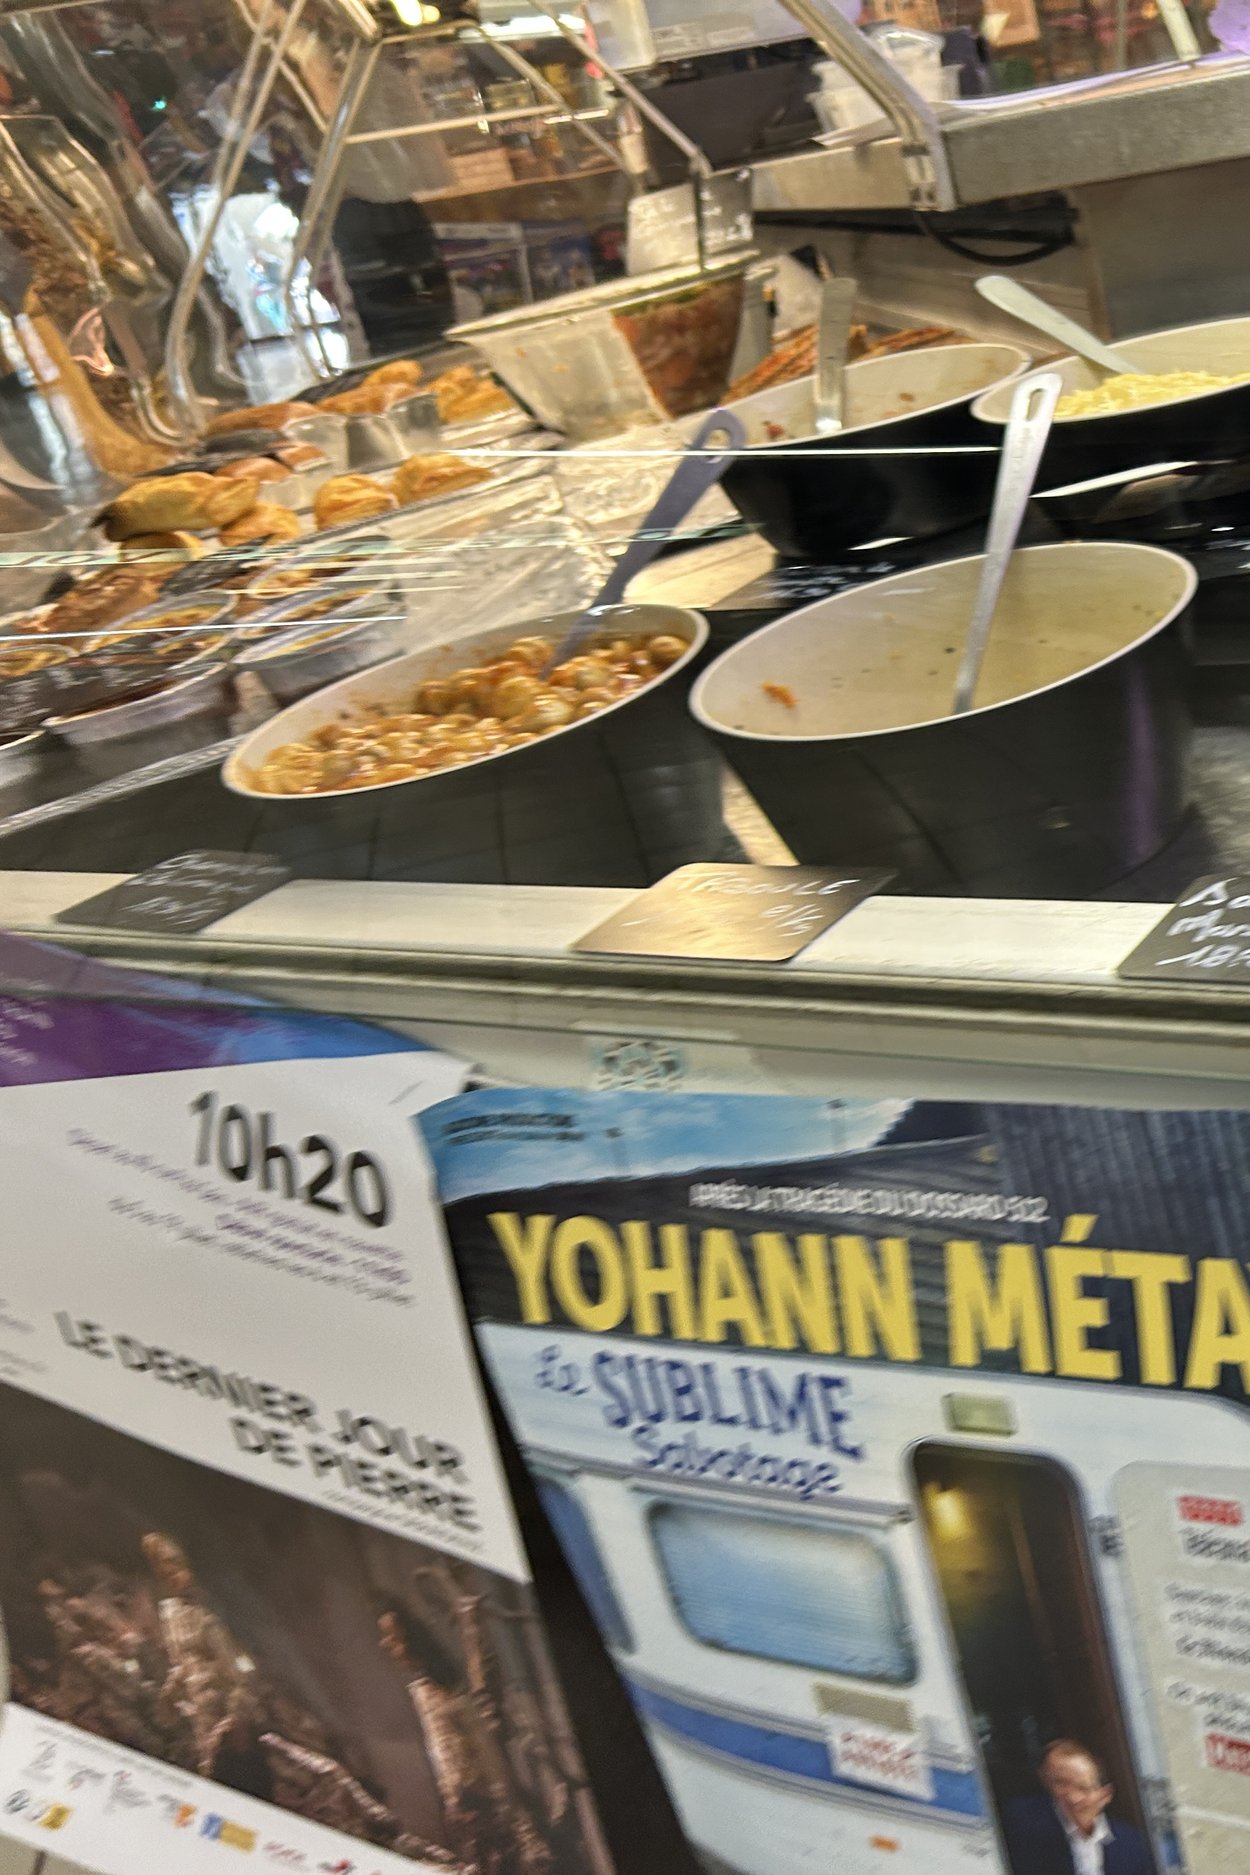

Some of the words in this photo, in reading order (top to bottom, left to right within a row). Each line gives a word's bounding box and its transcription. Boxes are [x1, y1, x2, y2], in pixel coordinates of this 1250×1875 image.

[188, 1090, 391, 1229] 10h20
[487, 1209, 922, 1364] YOHANN
[53, 1311, 113, 1359] LE
[112, 1334, 323, 1432] DERNIER
[333, 1408, 469, 1484] JOUR
[593, 1350, 866, 1460] SUBLIME
[229, 1416, 301, 1468] DE
[308, 1442, 483, 1531] PIERRE
[630, 1424, 844, 1501] Sabotage
